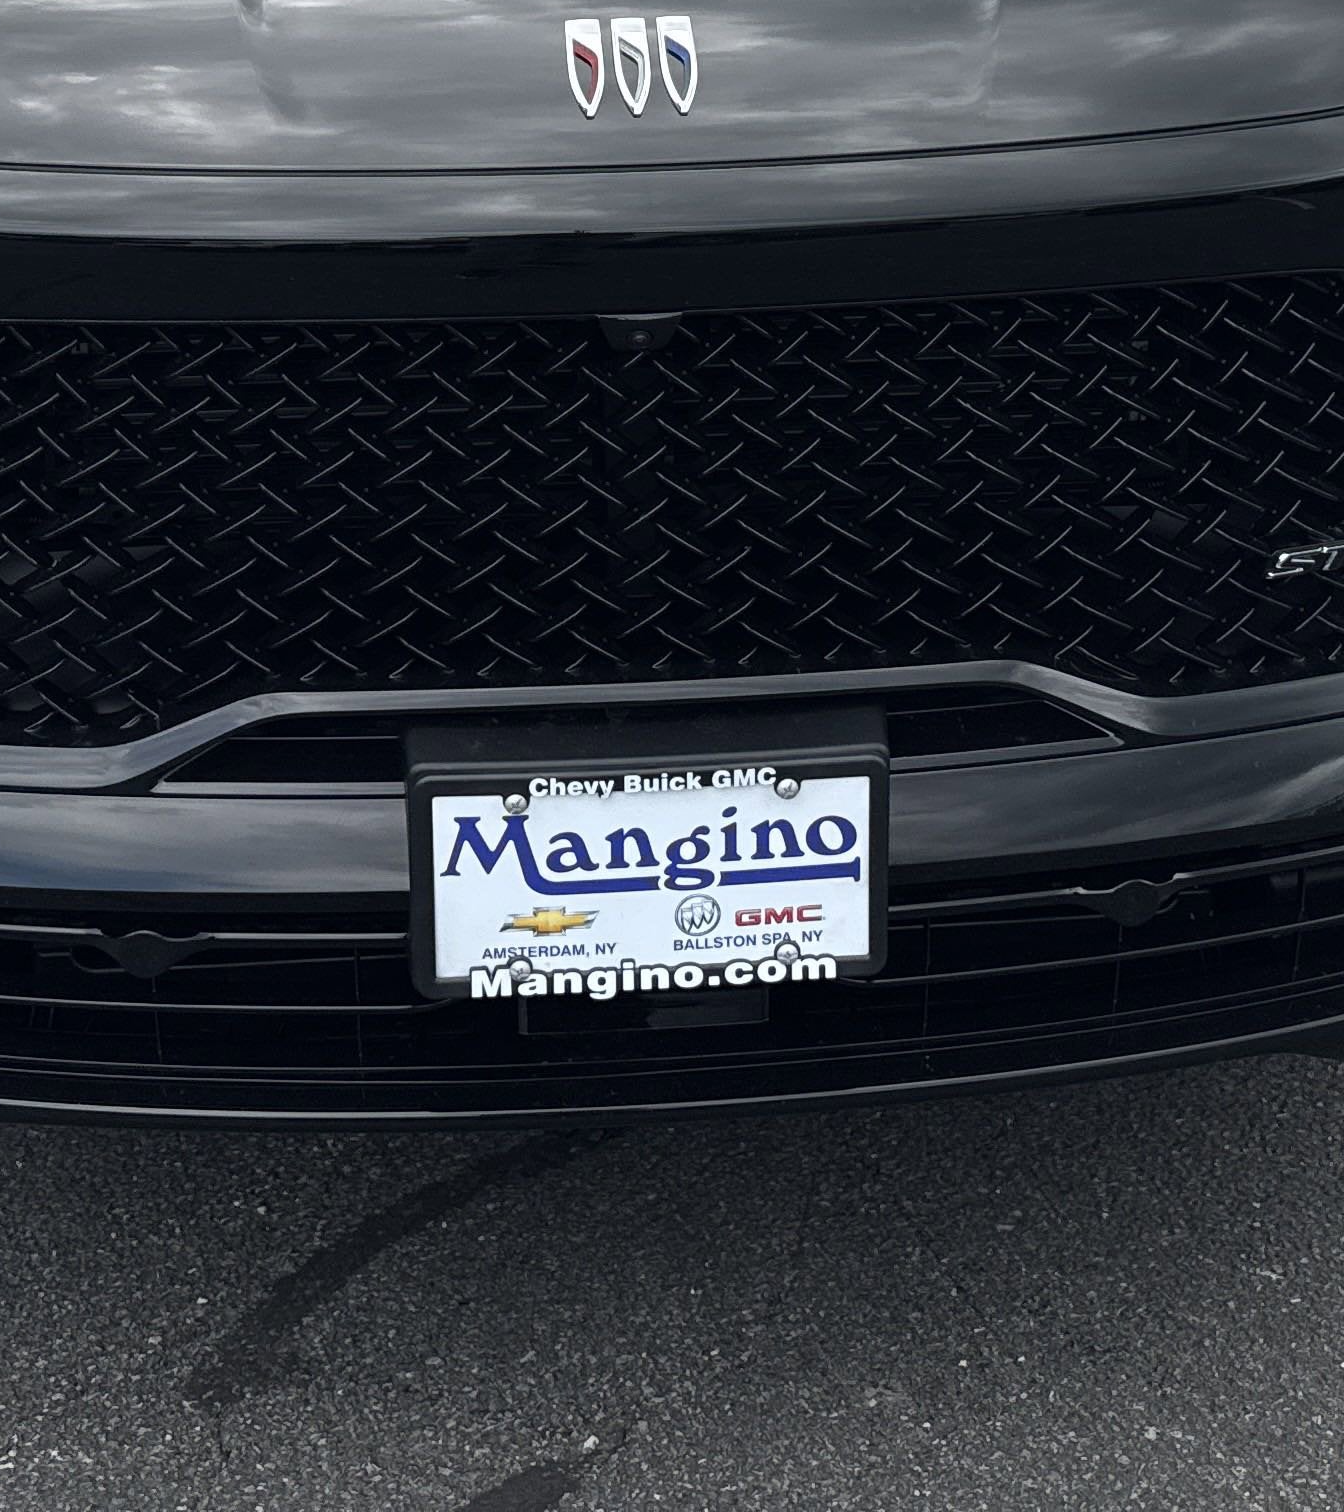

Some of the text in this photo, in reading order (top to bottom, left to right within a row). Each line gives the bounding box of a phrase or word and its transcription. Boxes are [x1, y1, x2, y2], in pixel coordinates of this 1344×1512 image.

[528, 767, 777, 798] Chevy Buick GMC
[440, 806, 860, 896] Mangino
[735, 904, 824, 927] GMC
[482, 943, 617, 959] AMSTERDAM, NY
[673, 934, 757, 951] BALLSTON
[801, 929, 823, 942] NY
[470, 954, 837, 1000] Mangino.com
